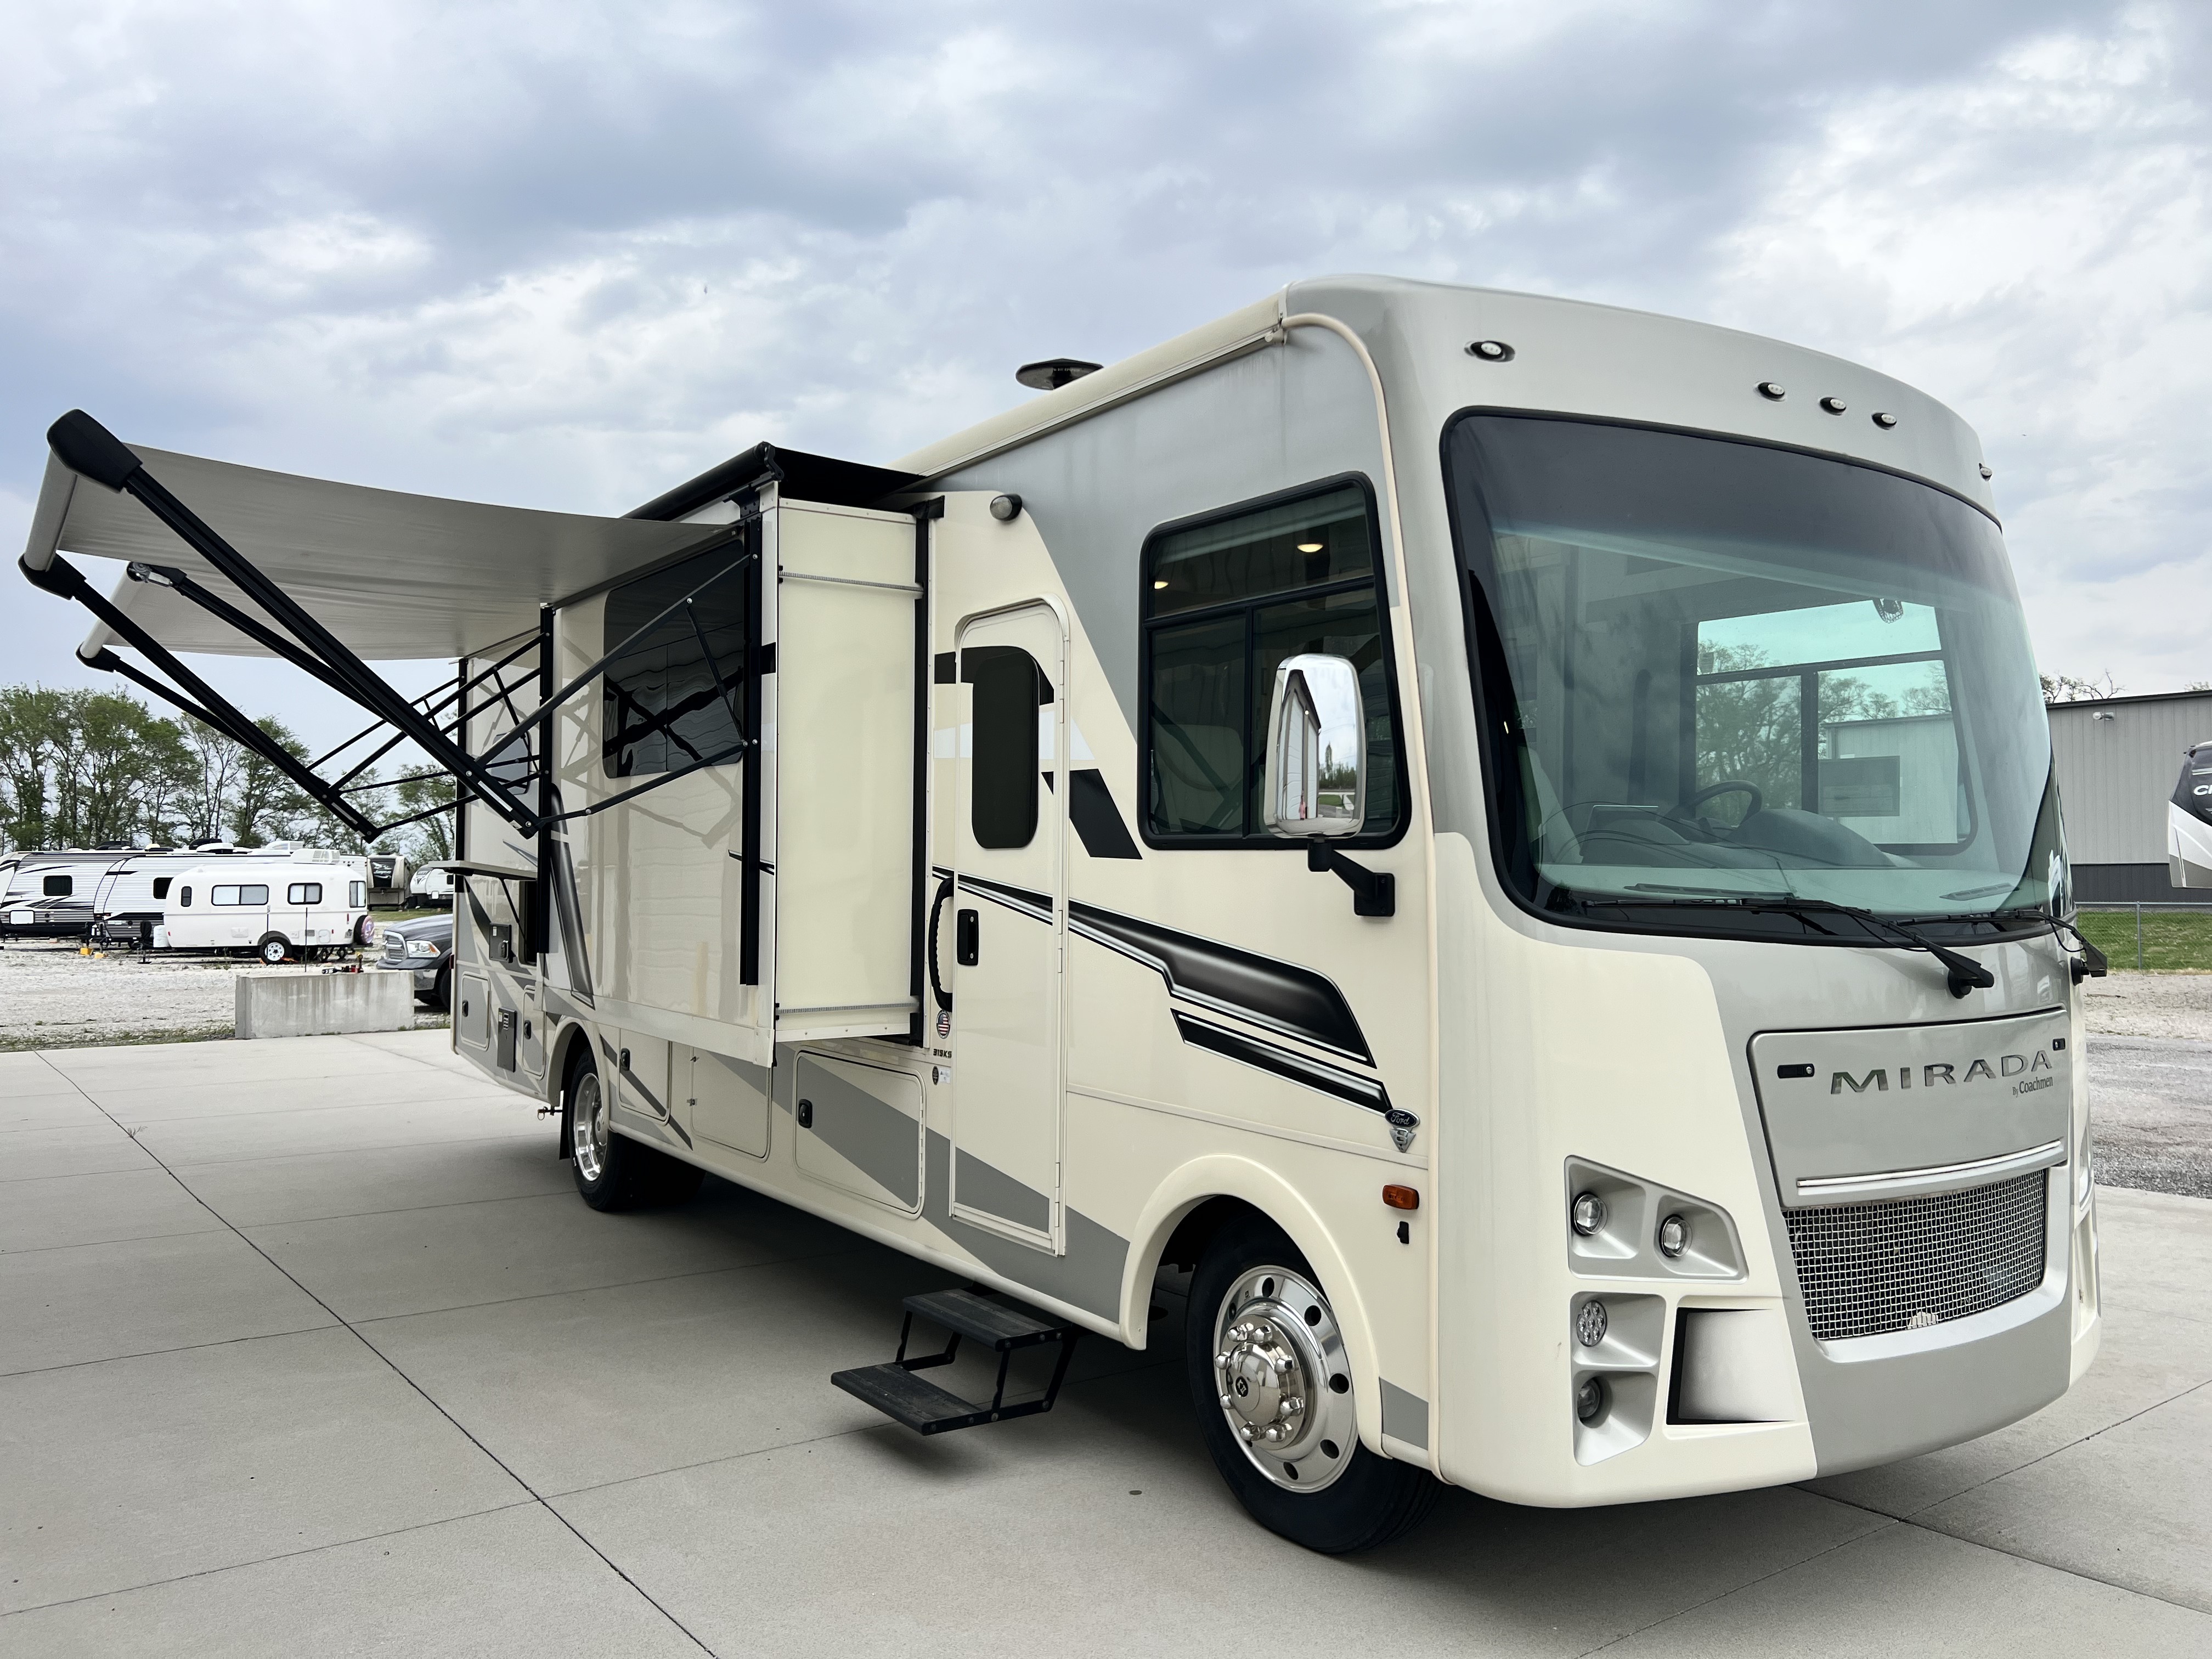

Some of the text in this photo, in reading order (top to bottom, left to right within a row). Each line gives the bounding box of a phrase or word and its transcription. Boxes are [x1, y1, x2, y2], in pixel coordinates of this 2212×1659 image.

[2194, 785, 2212, 795] C
[1831, 1050, 2052, 1094] MIRADA
[2012, 1076, 2053, 1098] By Coachmen
[1390, 1112, 1410, 1125] Ford
